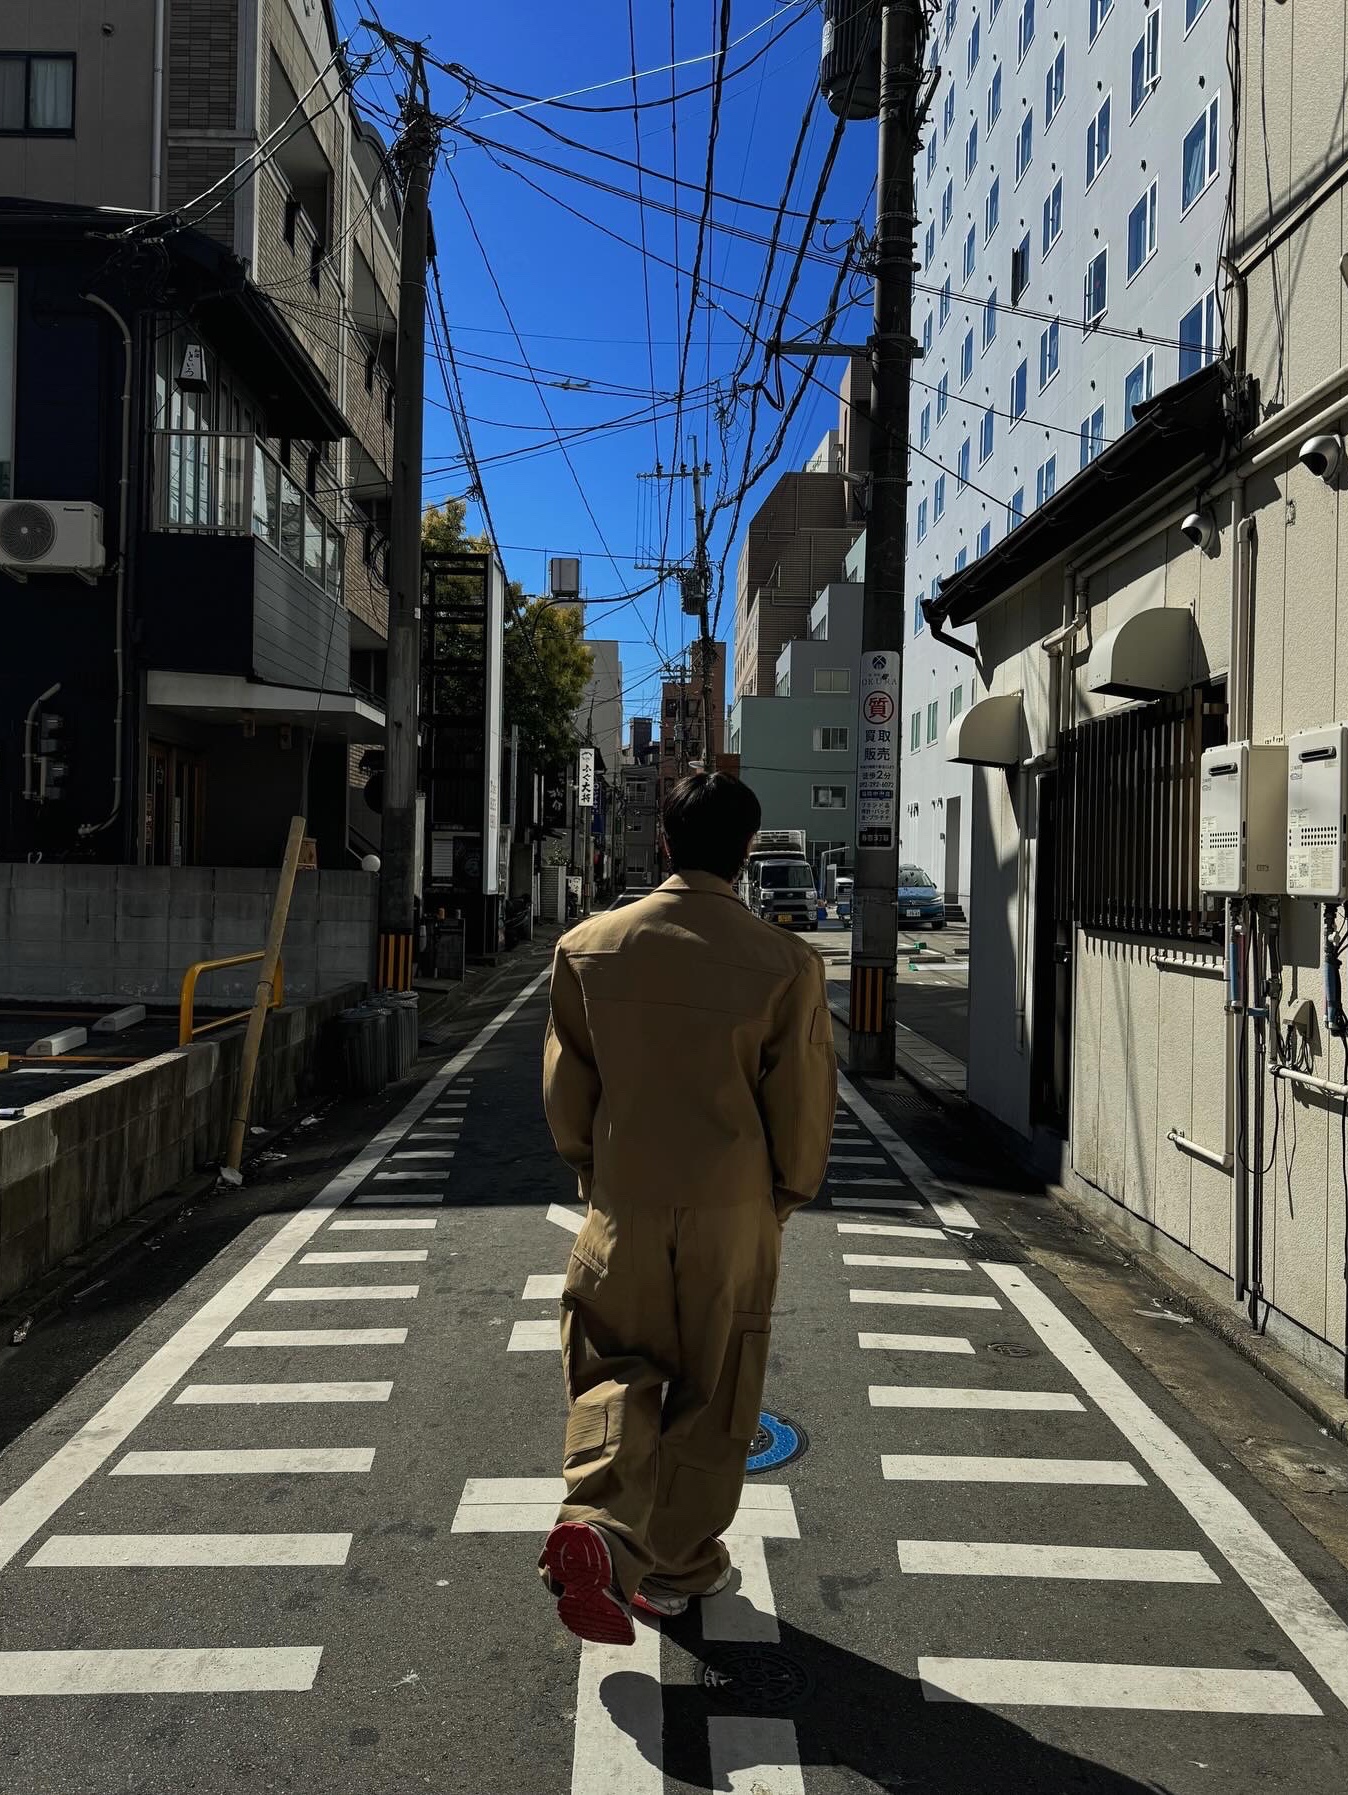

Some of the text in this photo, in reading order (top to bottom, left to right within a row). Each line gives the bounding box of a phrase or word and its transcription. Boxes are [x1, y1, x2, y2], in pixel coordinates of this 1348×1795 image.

[868, 697, 889, 719] 質
[865, 729, 891, 743] 買取
[864, 747, 891, 761] 販売
